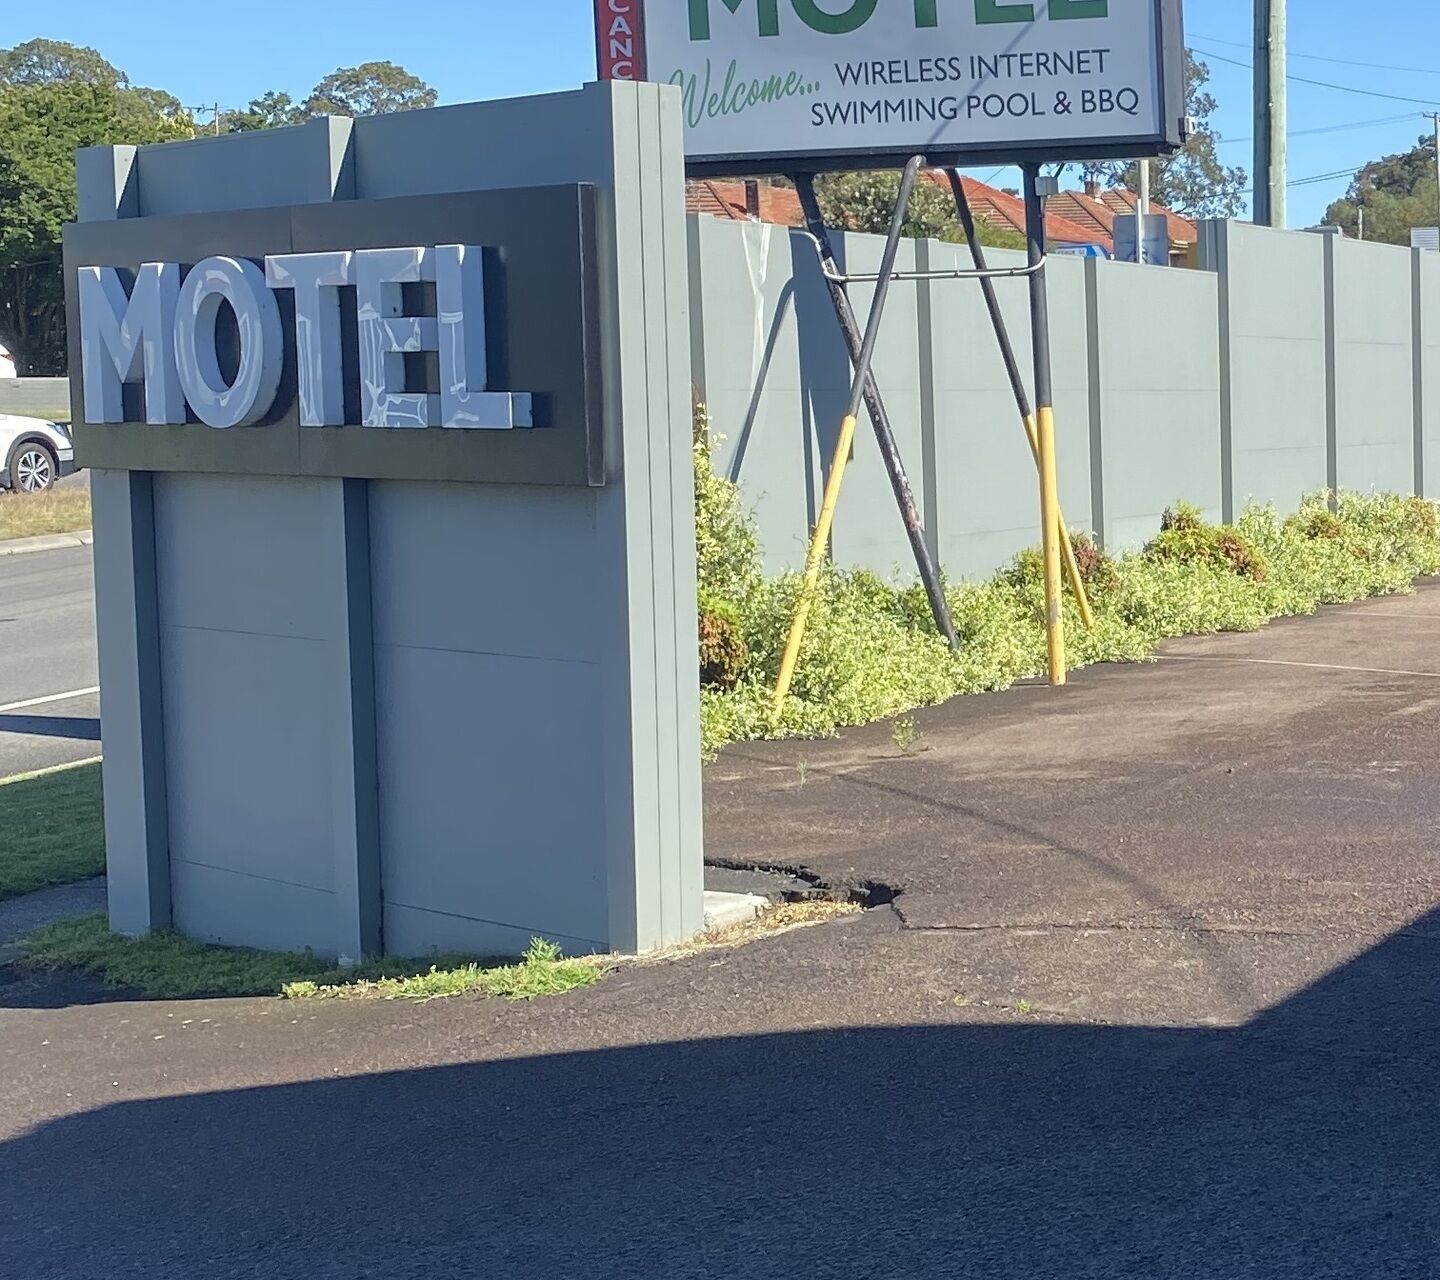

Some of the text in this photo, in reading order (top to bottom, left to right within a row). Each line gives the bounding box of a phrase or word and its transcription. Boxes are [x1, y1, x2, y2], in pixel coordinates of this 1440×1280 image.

[834, 49, 1110, 86] WIRELESS INTERNET
[811, 87, 1139, 126] SWIMMING POOL & BBQ
[78, 244, 533, 430] MOTEL
